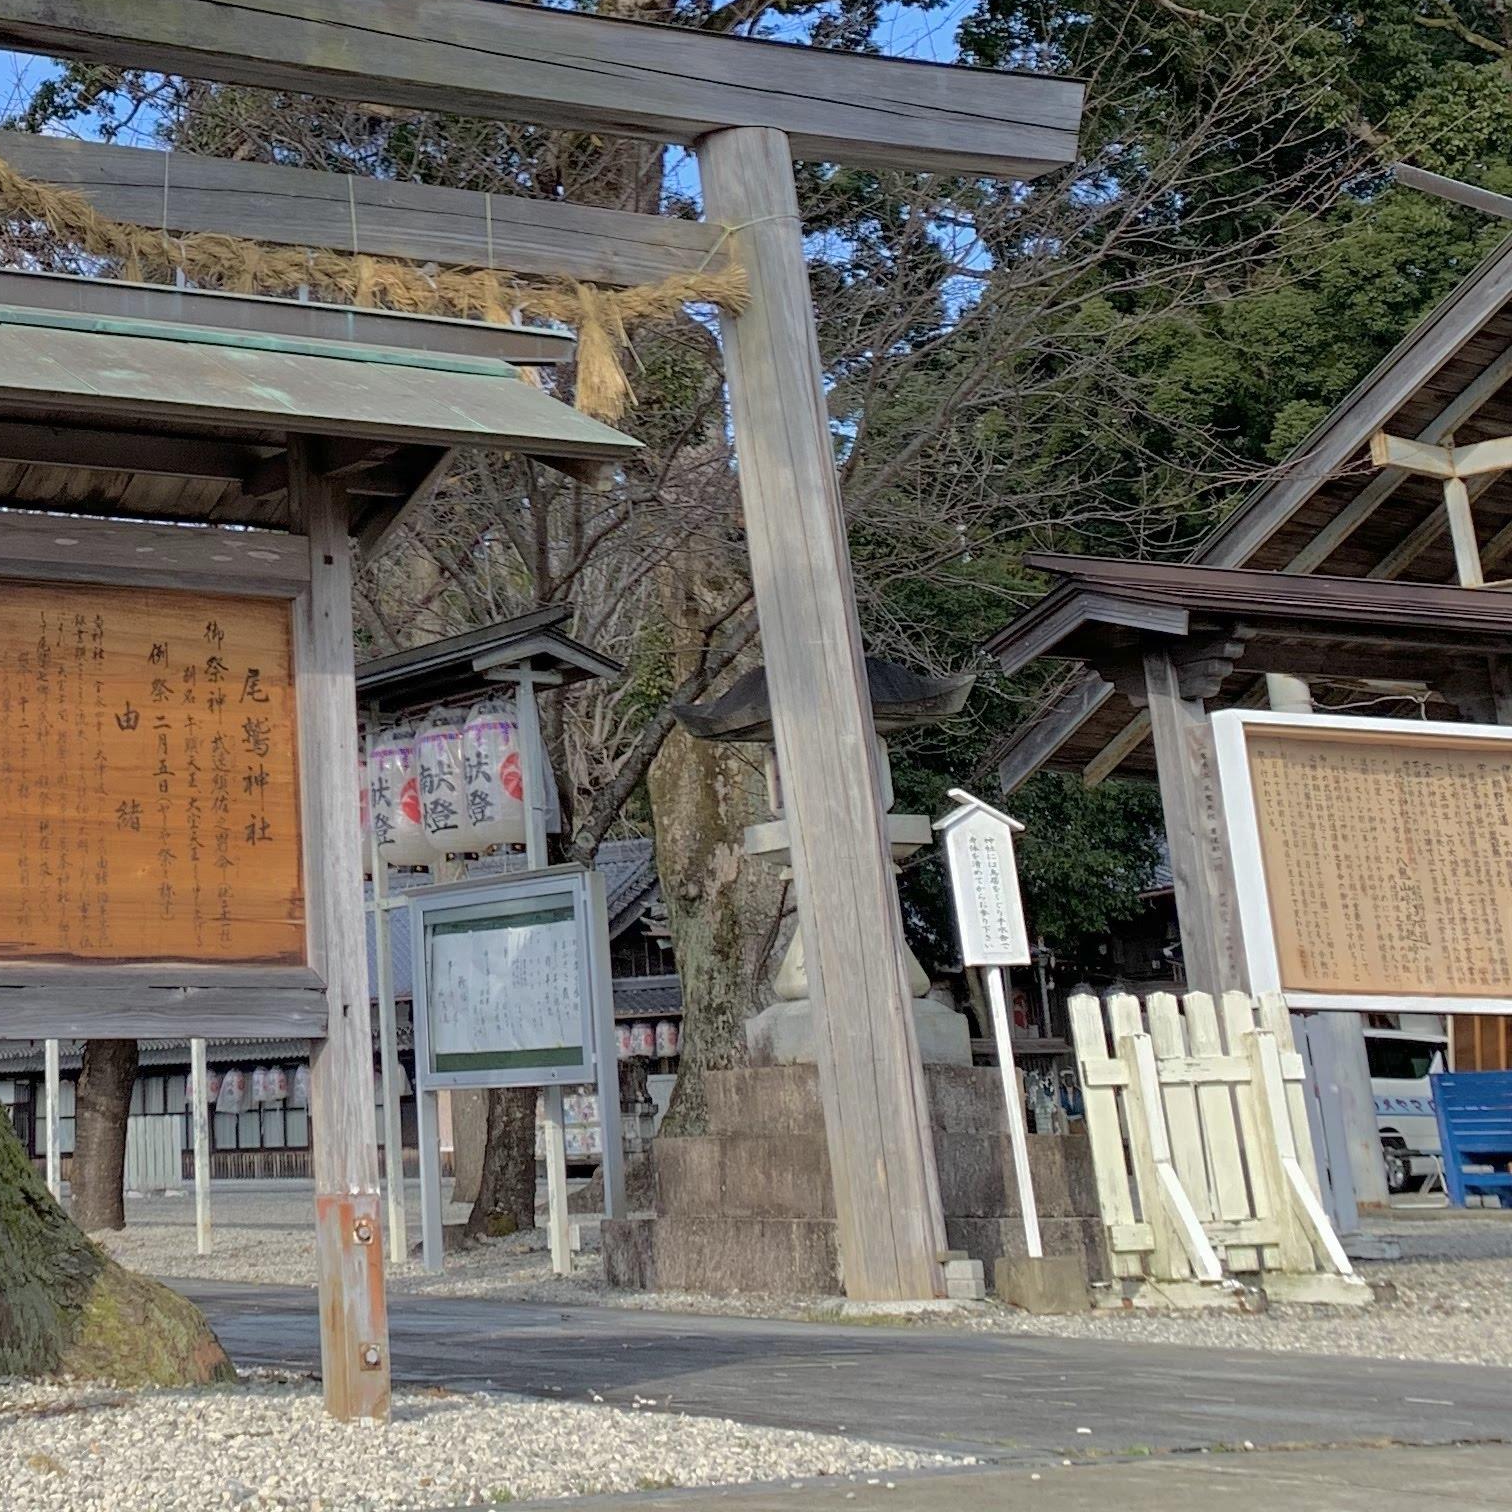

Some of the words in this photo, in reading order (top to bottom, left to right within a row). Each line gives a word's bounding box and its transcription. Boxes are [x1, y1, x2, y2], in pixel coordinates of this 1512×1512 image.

[239, 667, 273, 846] 尾鷲神社
[418, 761, 459, 834] 献燈
